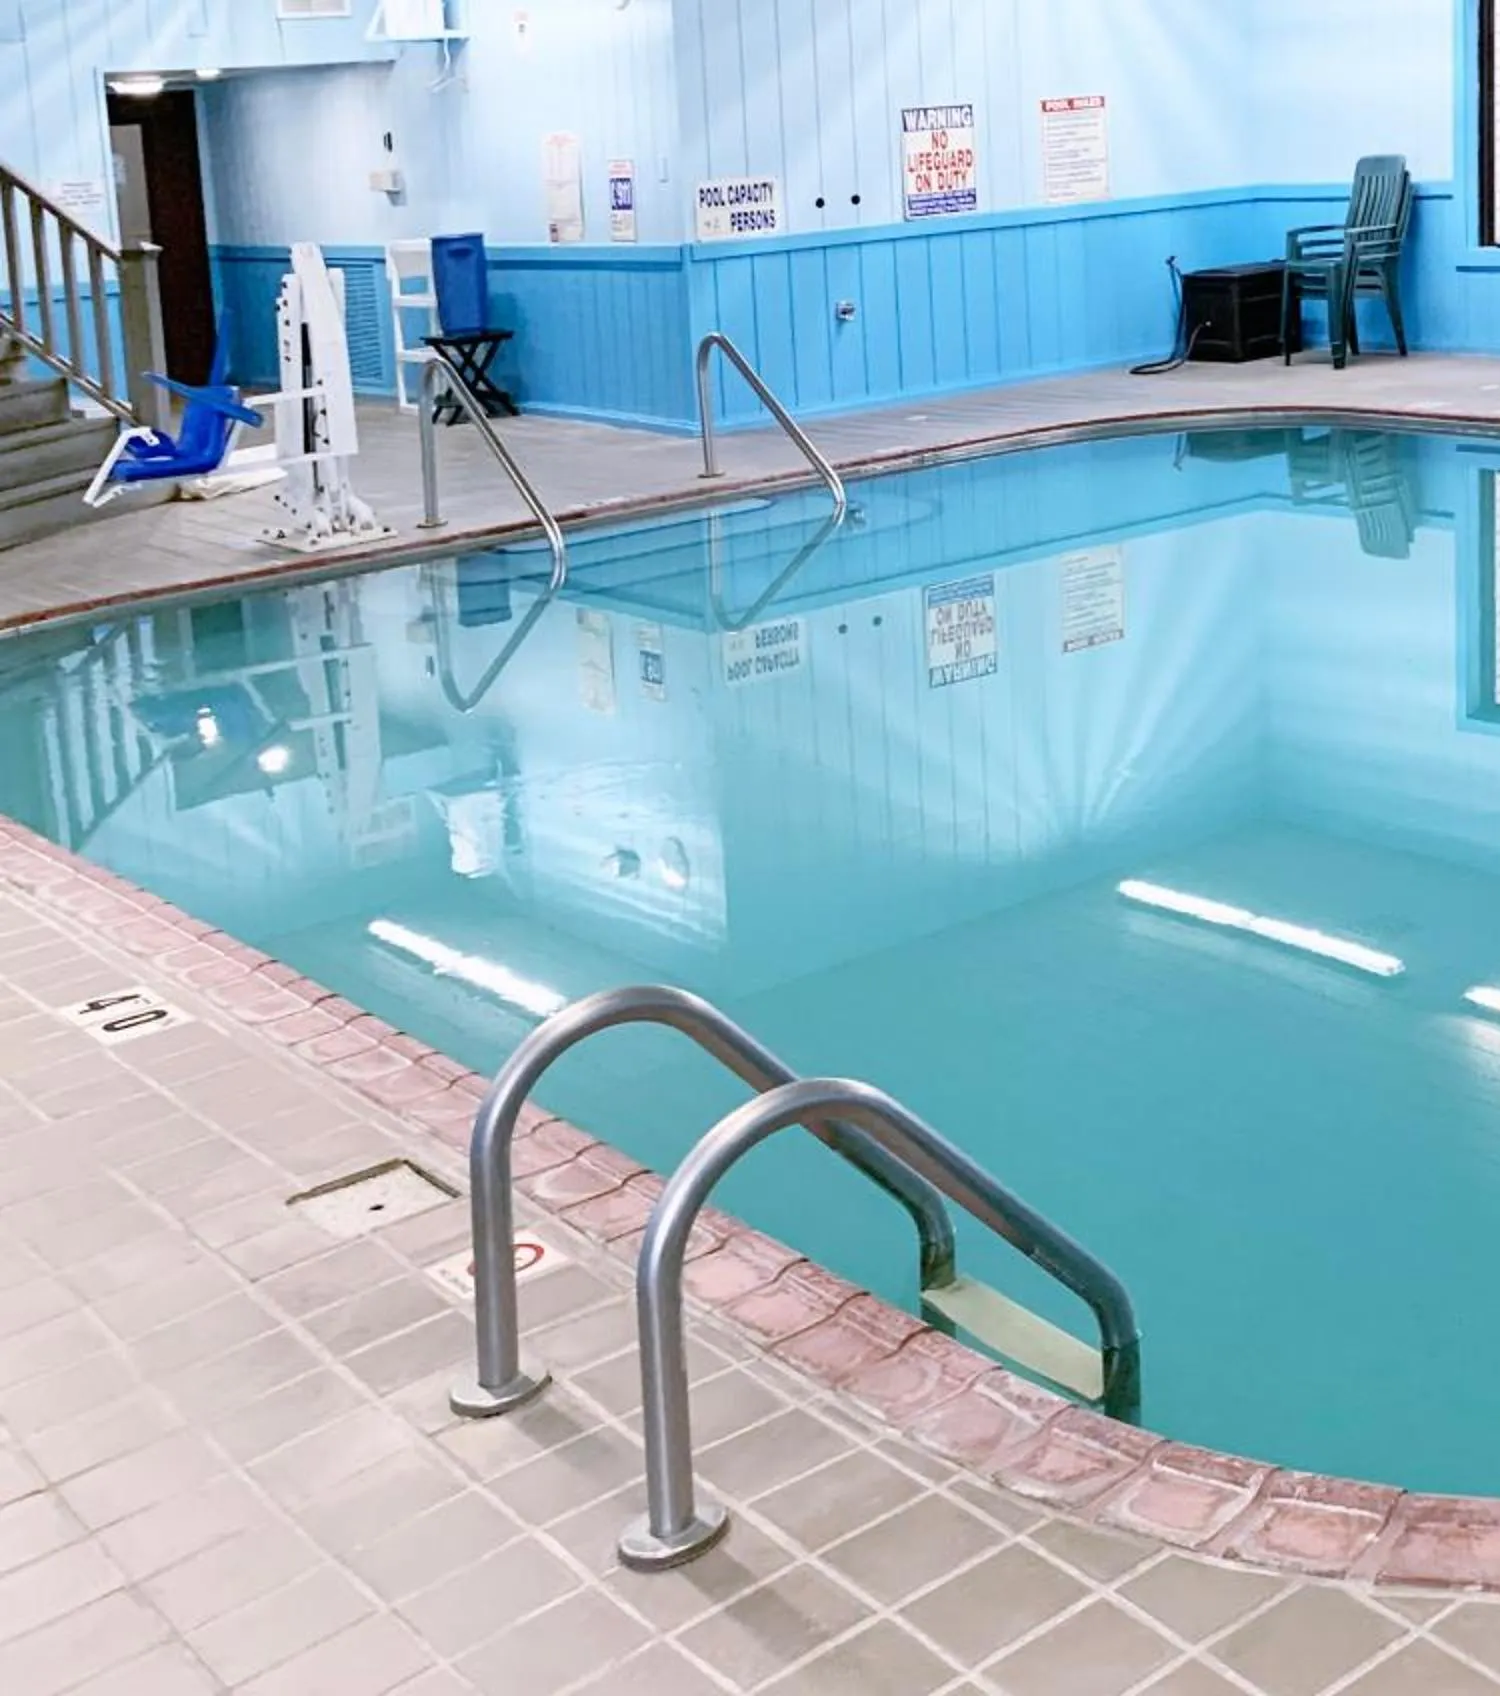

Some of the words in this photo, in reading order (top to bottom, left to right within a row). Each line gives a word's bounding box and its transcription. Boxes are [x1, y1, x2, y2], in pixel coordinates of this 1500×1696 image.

[903, 107, 972, 132] WARNING
[931, 130, 948, 150] NO
[907, 149, 972, 172] LIFEGUARD
[916, 174, 932, 192] ON
[938, 171, 966, 190] DUTY
[699, 187, 725, 208] POOL
[728, 182, 773, 205] CAPACITY
[731, 209, 776, 232] PERSONS
